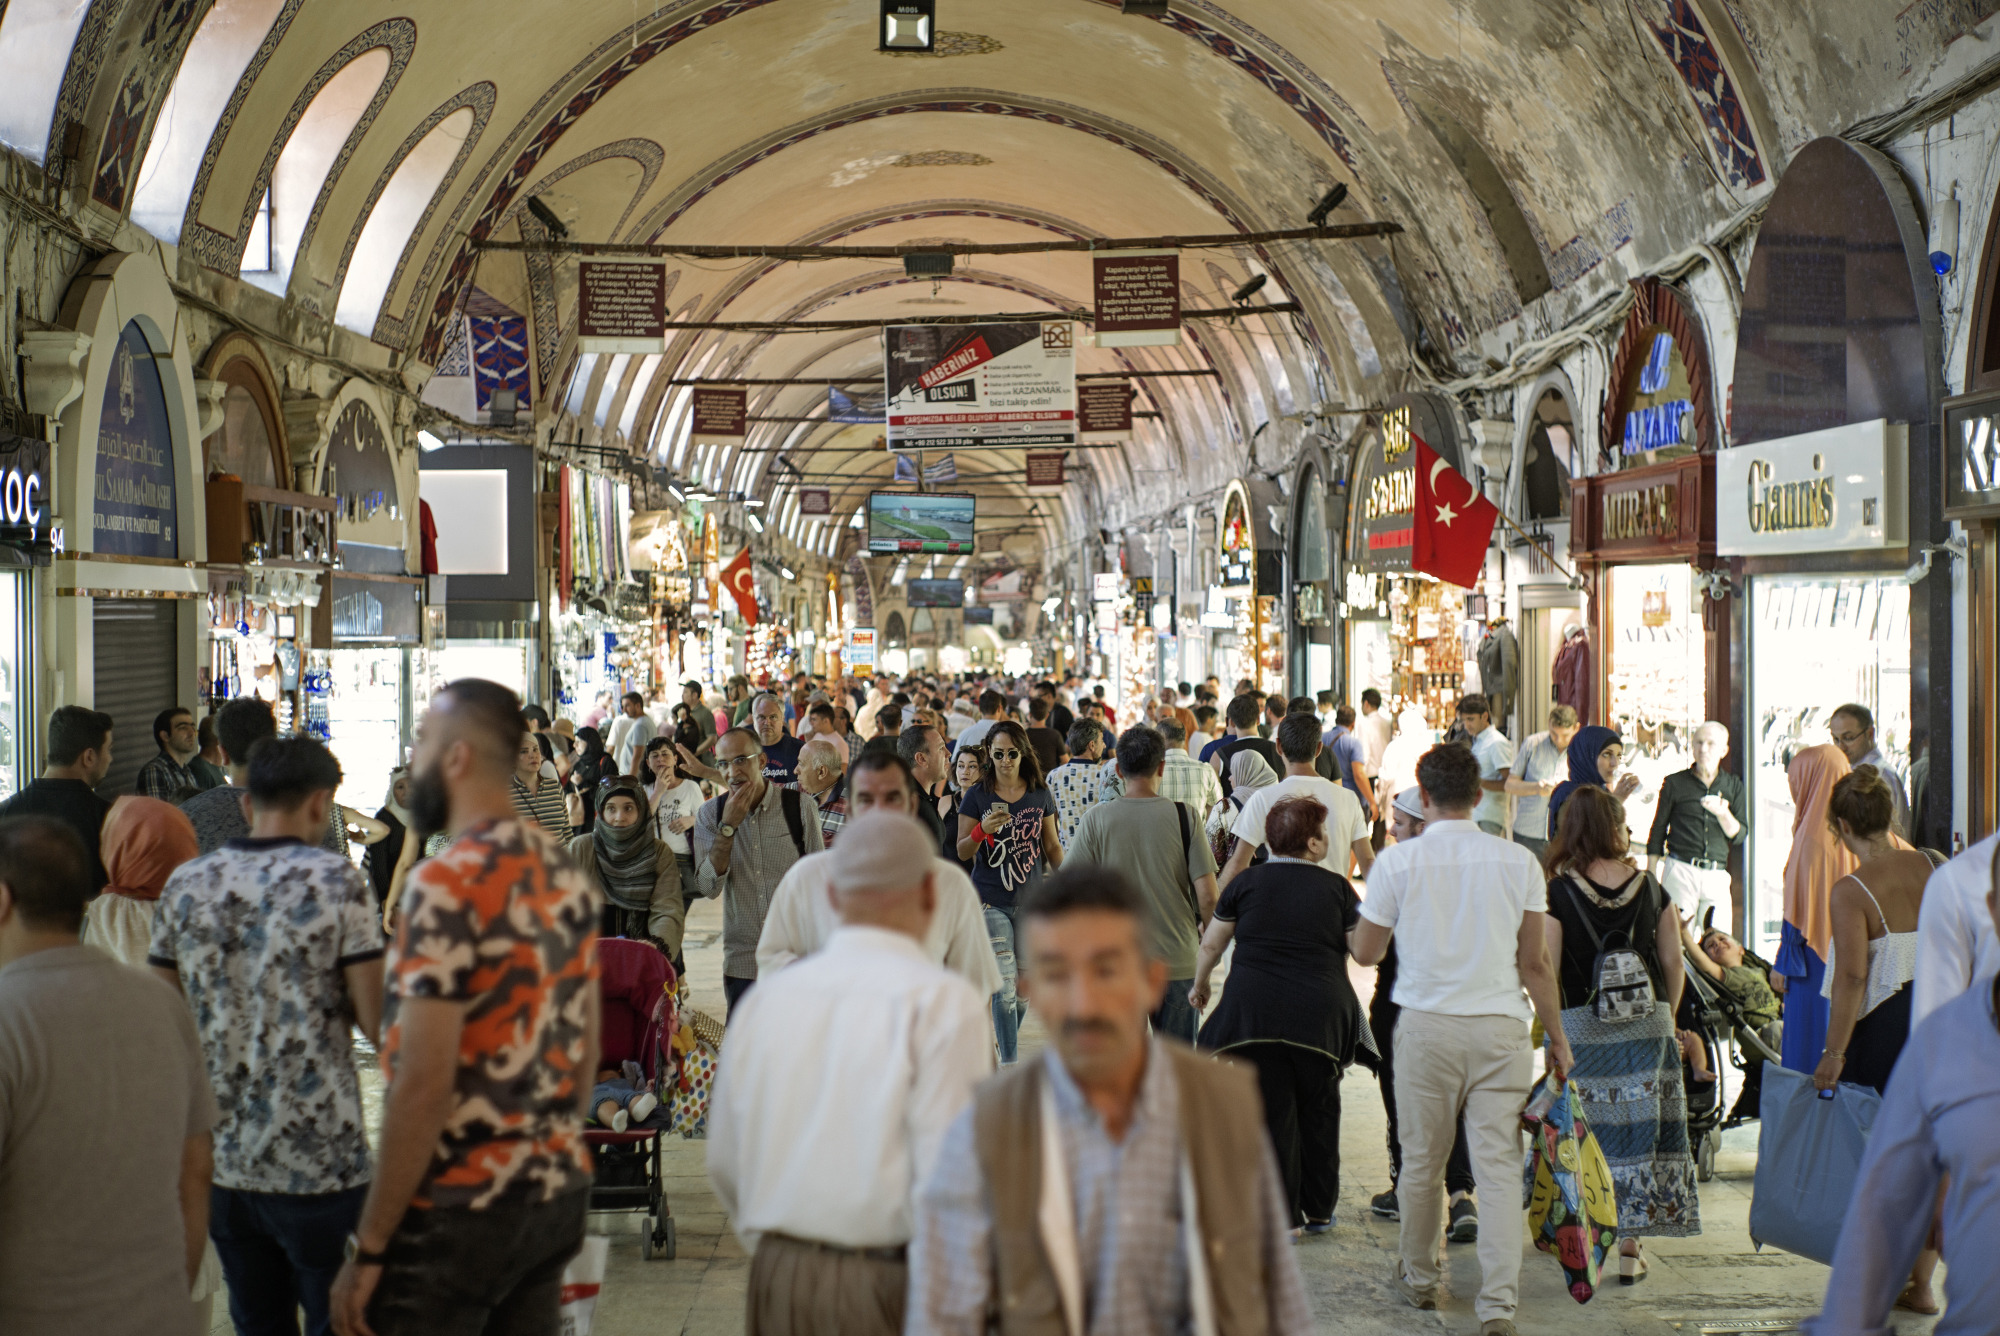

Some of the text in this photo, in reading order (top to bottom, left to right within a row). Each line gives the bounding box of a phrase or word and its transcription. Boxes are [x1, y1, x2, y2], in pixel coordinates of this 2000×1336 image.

[588, 311, 607, 319] Today
[921, 347, 979, 387] HABERİNİZ
[930, 385, 968, 400] OLSUN!
[1007, 398, 1028, 406] takip
[1031, 397, 1051, 405] edin!
[904, 416, 943, 424] ÇARŞIMIZDA
[968, 414, 997, 422] OLUYOR?
[998, 412, 1035, 420] HABERİNİZ
[1036, 411, 1061, 419] OLSUN!
[1747, 453, 1838, 534] Giannis
[107, 515, 125, 531] AMBER
[126, 516, 133, 532] VE
[134, 514, 160, 535] PARFÜMERİ
[51, 527, 64, 553] 94
